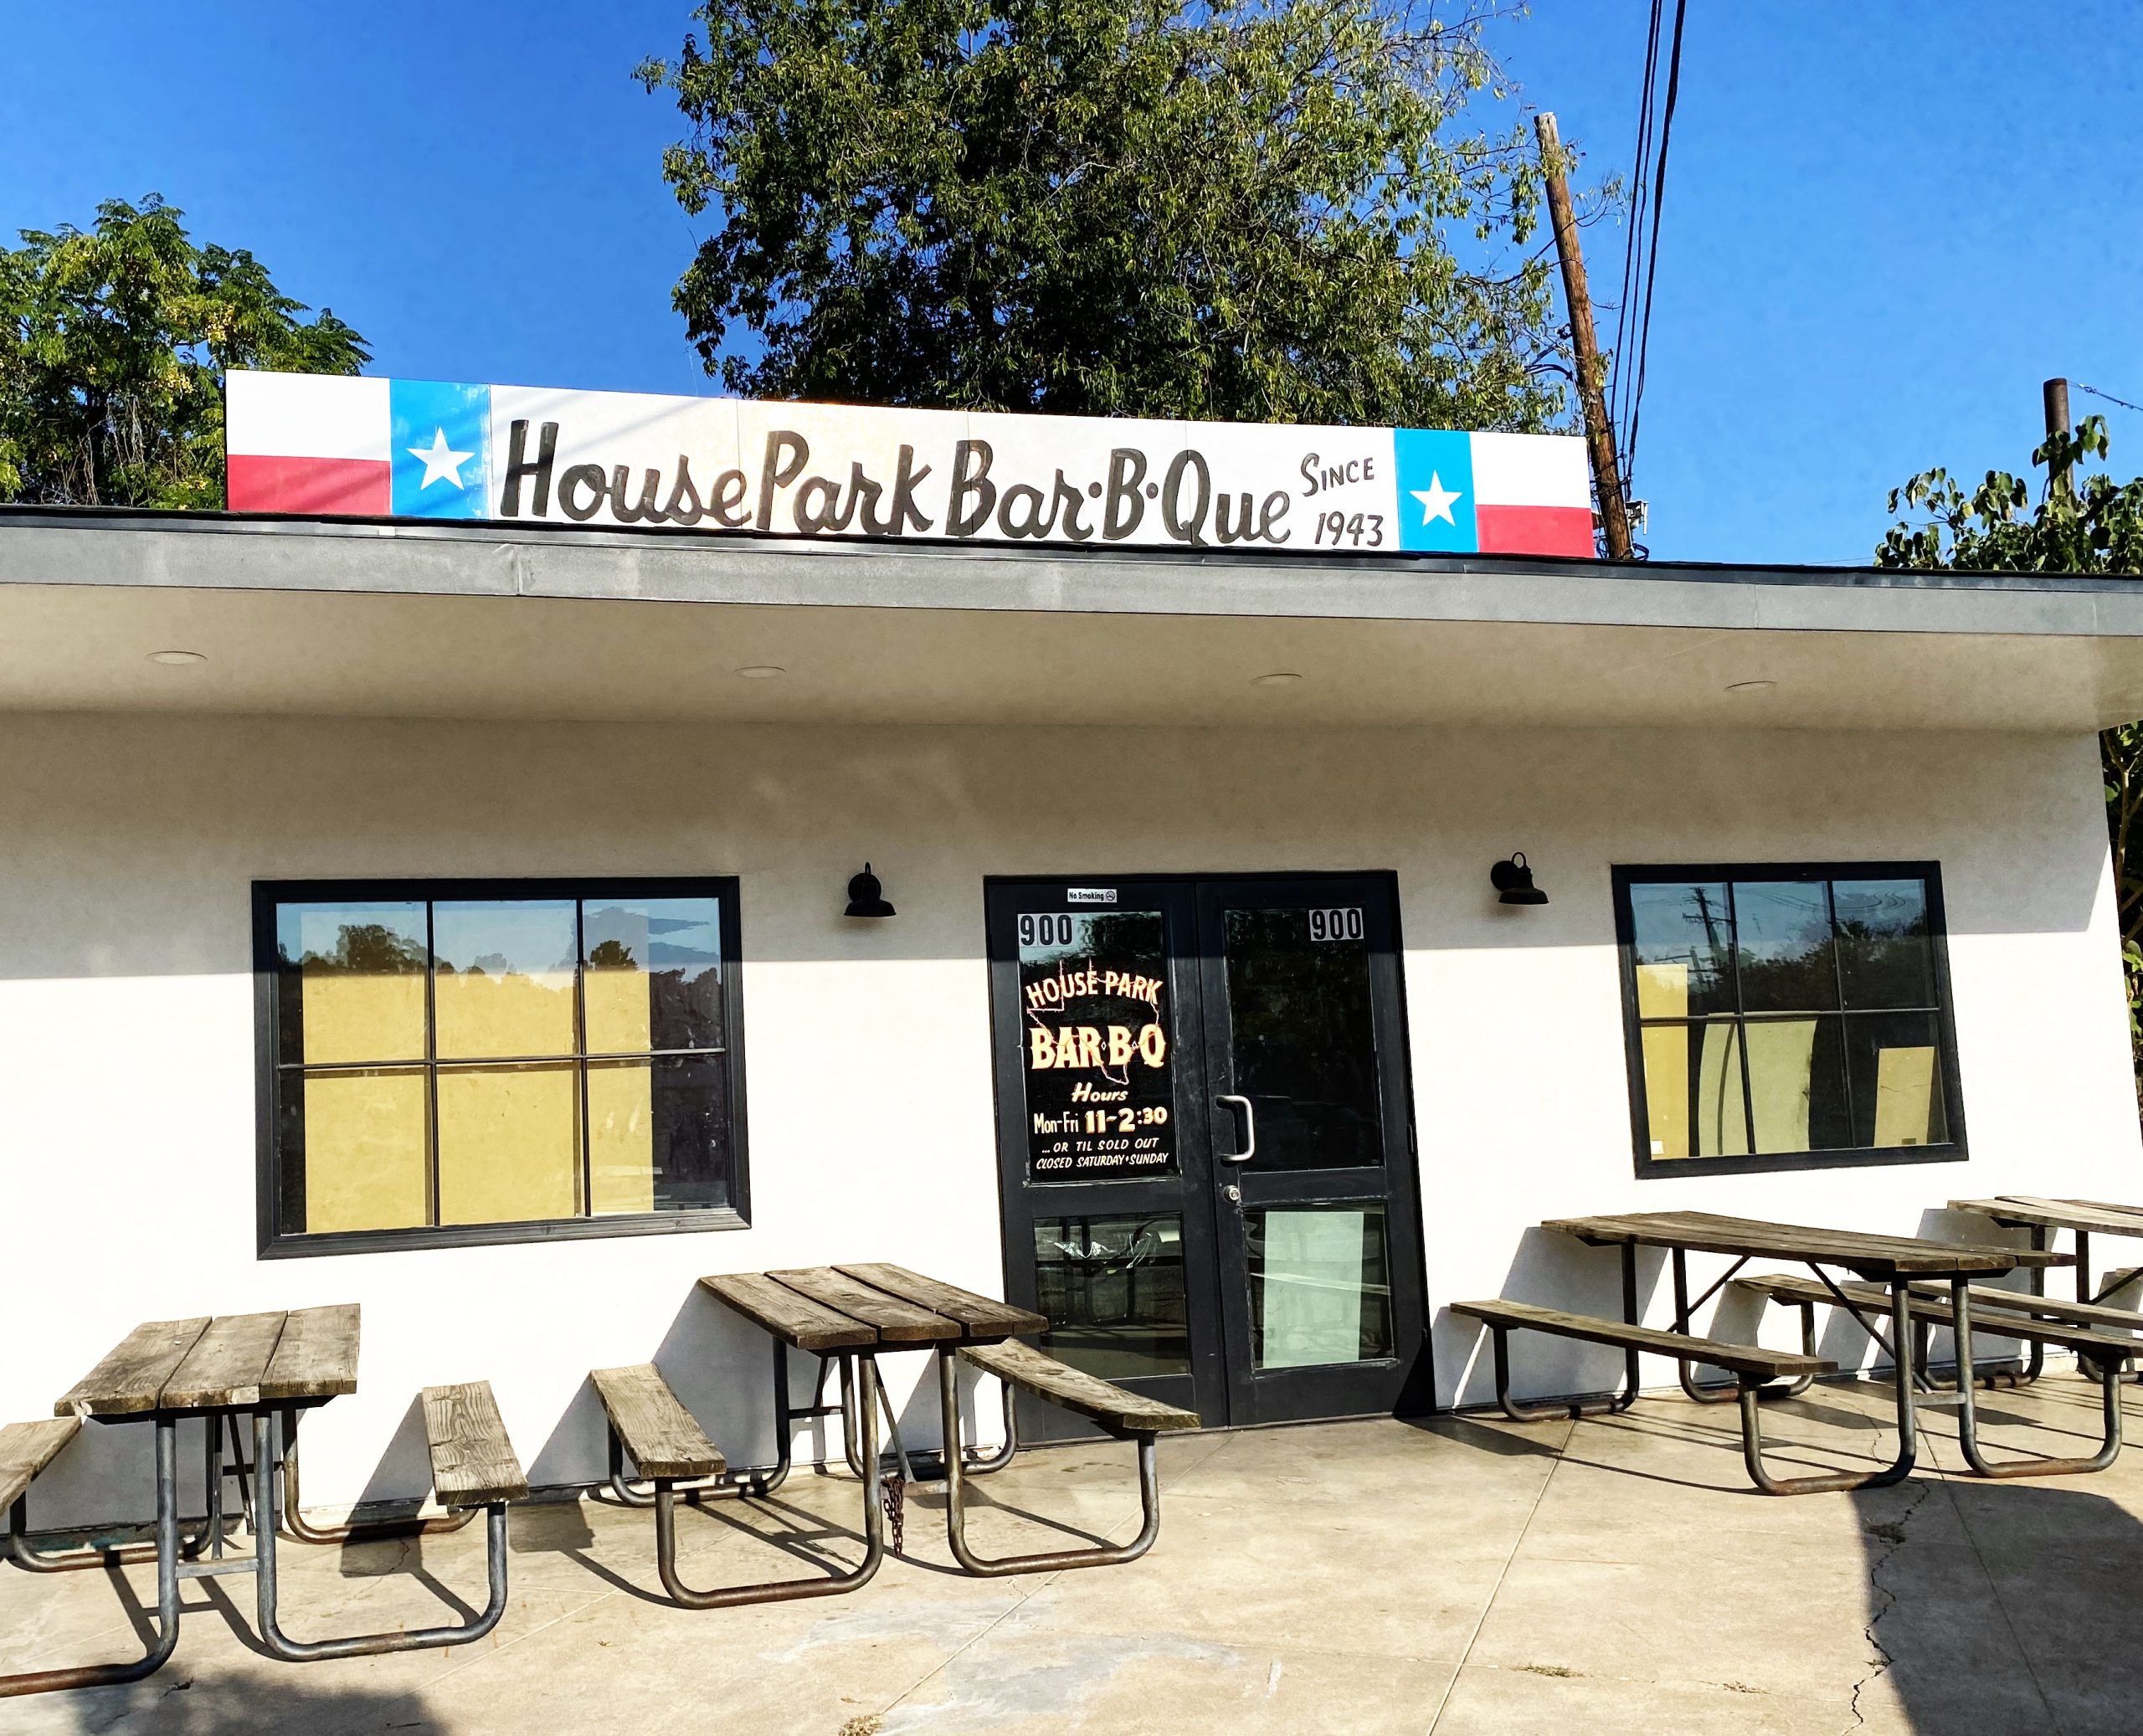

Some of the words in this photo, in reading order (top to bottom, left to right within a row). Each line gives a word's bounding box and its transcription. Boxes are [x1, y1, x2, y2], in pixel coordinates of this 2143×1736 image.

[500, 419, 752, 527] House
[756, 429, 934, 536] Park
[1314, 511, 1384, 547] 1943
[1069, 891, 1077, 900] No
[1078, 891, 1104, 901] Smoking
[1020, 914, 1072, 946] 900
[1312, 908, 1361, 940] 900
[1025, 970, 1098, 1008] HOUSE
[1105, 970, 1164, 1004] PARK
[1072, 1082, 1128, 1102] Hours
[1034, 1111, 1079, 1134] Mon-Fri
[1085, 1107, 1168, 1134] 11-2:30
[1077, 1141, 1092, 1152] TIL
[1097, 1139, 1128, 1150] SOLD
[1134, 1138, 1159, 1148] OUT
[1036, 1157, 1072, 1169] CLOSED
